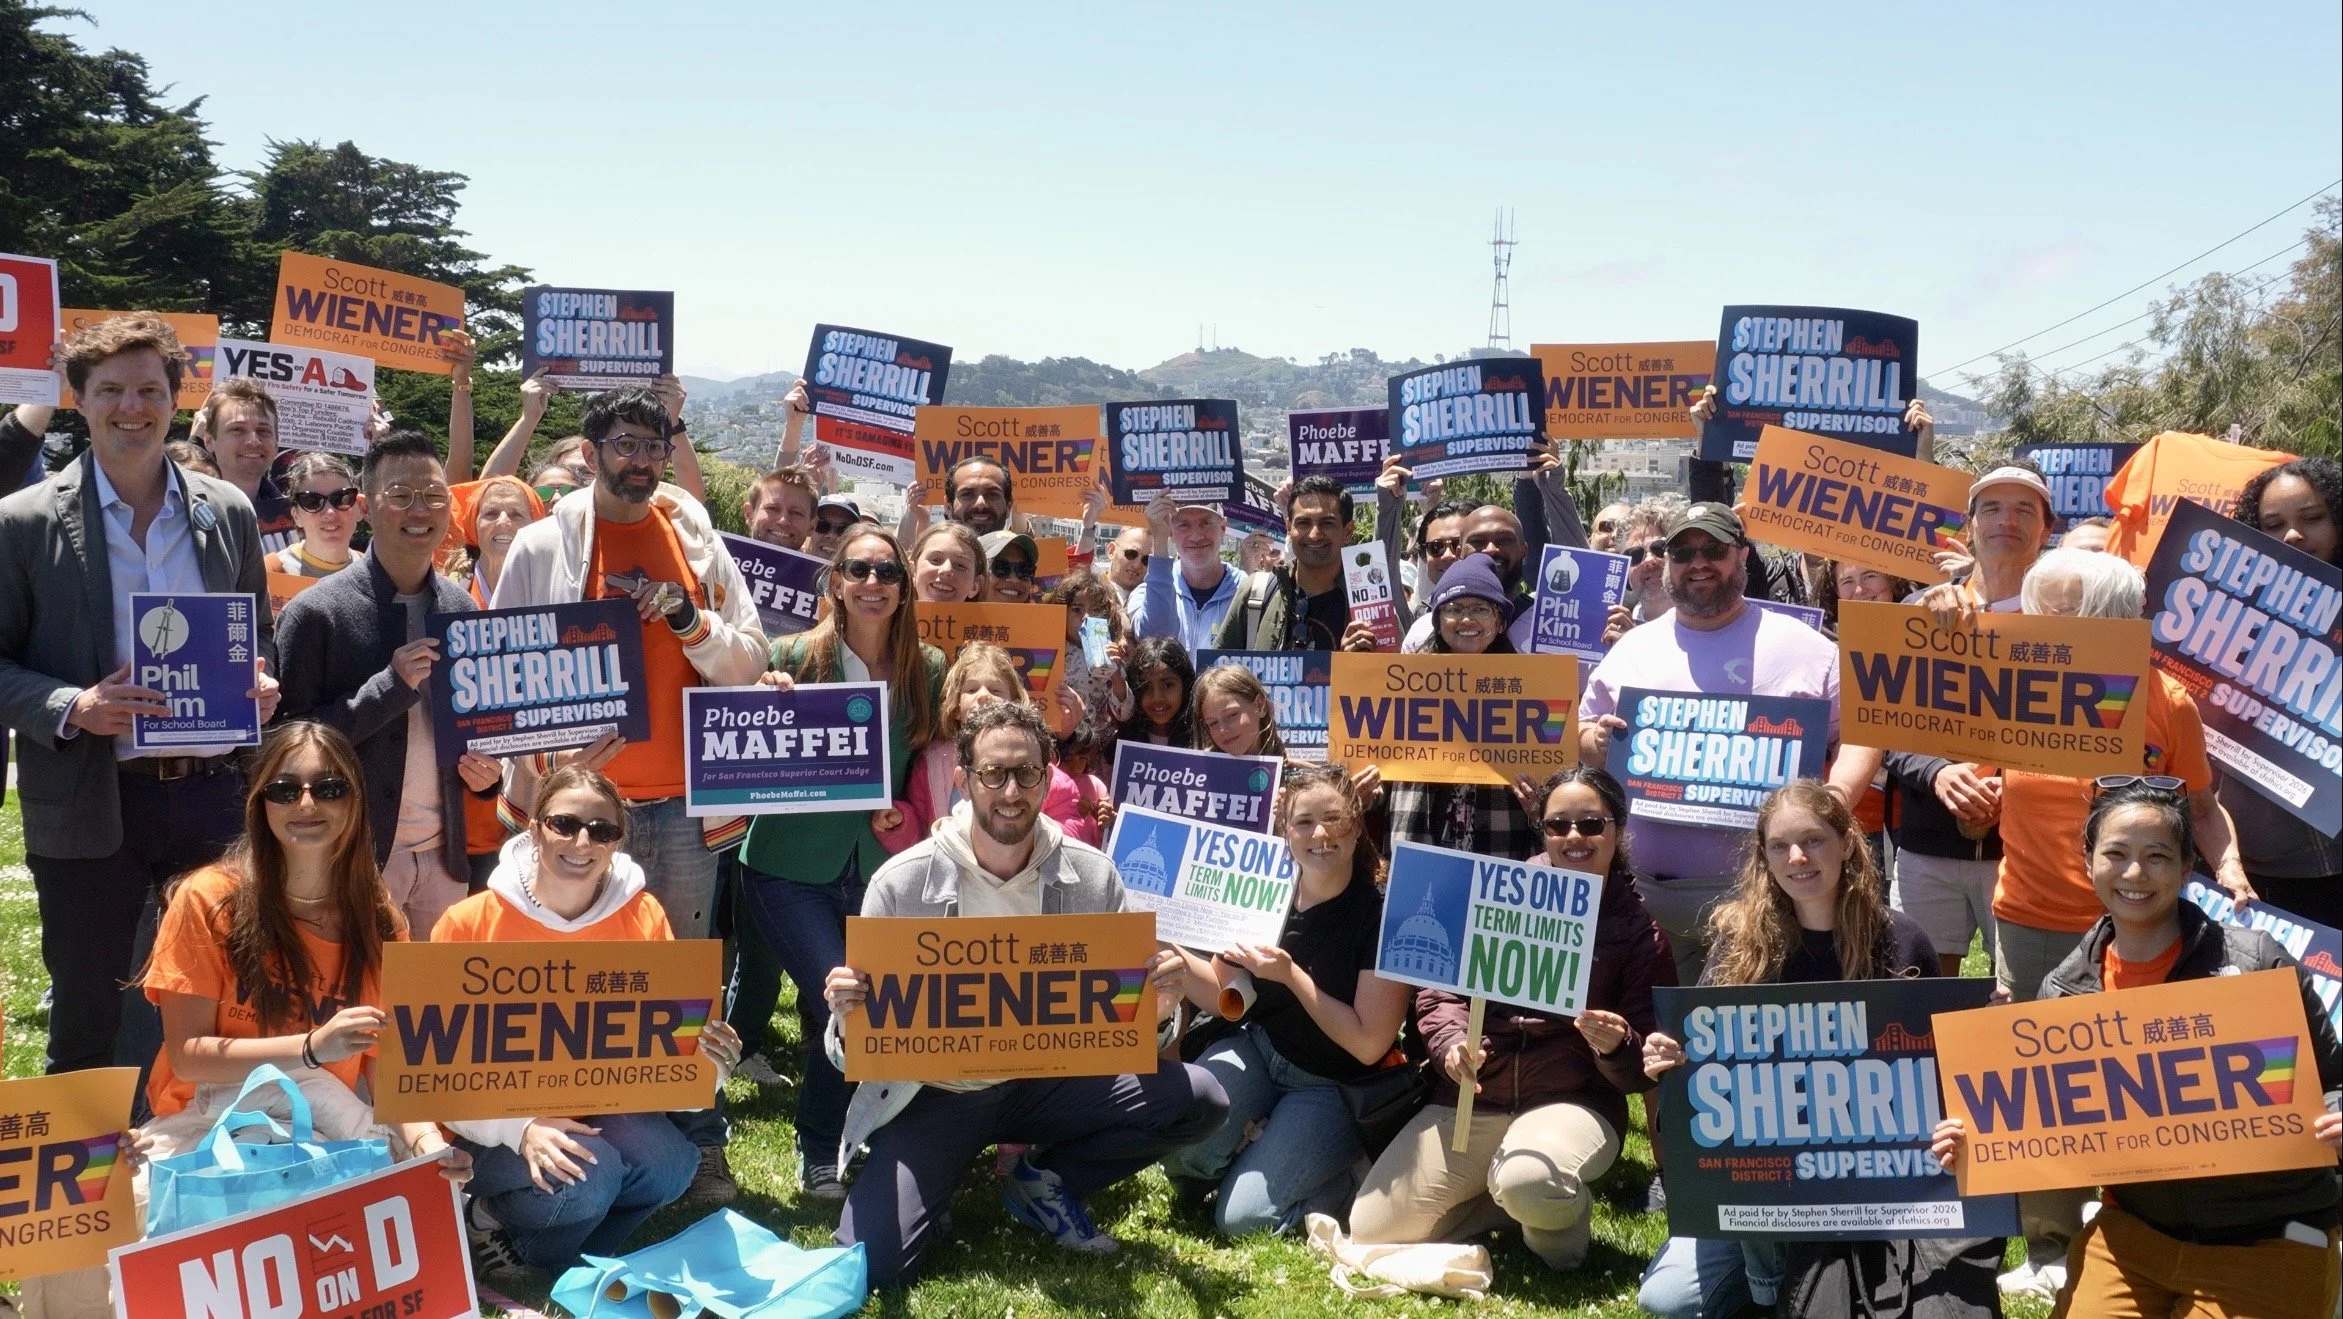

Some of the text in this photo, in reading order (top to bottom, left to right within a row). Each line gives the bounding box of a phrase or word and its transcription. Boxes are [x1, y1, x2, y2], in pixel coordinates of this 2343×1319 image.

[324, 268, 427, 307] Scott 威善高
[285, 285, 445, 346] WIENER
[537, 292, 618, 320] STEPHEN
[285, 323, 379, 350] DEMOCRAT FOR
[536, 318, 663, 360] SHERRILL
[823, 330, 898, 363] STEPHEN
[1732, 316, 1844, 355] STEPHEN
[223, 347, 293, 382] YES
[300, 358, 327, 387] A
[579, 360, 660, 374] SUPERVISOR
[1571, 351, 1674, 373] Scott 威善高
[320, 388, 336, 396] Safer
[337, 390, 367, 400] Tomorrow
[815, 353, 931, 405] SHERRILL
[1401, 366, 1482, 407] STEPHEN
[1544, 374, 1695, 409] WIENER
[1726, 352, 1906, 413] SHERRILL
[957, 415, 1061, 438] Scott 威善高
[1119, 405, 1195, 433] STEPHEN
[1299, 423, 1356, 440] Phoebe
[1402, 392, 1535, 447] SHERRILL
[1614, 416, 1631, 424] FOR
[1742, 411, 1781, 420] FRANCISCO
[1783, 411, 1900, 435] SUPERVISOR
[835, 451, 894, 473] NoOnDSF.com
[1121, 431, 1235, 471] SHERRILL
[2028, 448, 2113, 474] STEPHEN
[1021, 476, 1090, 489] CONGRESS
[1163, 471, 1234, 486] SUPERVISOR
[1804, 445, 1929, 498] Scott 威善高
[2177, 478, 2222, 496] Scott
[1758, 463, 1946, 546] WIENER
[1750, 506, 1857, 545] DEMOCRAT FOR
[1352, 585, 1388, 604] NO D
[1602, 559, 1624, 604] 菲爾金
[2180, 528, 2342, 637] STEPHEN
[1354, 604, 1390, 620] DON'T
[1540, 596, 1580, 620] Phil
[227, 602, 248, 663] 菲爾金
[447, 613, 559, 658] STEPHEN
[963, 626, 1010, 643] 威善高
[1537, 636, 1592, 649] For School Board
[1538, 615, 1580, 639] Kim
[1905, 617, 2073, 665] Scott 威善高
[451, 644, 629, 714] SHERRILL
[1386, 663, 1523, 695] Scott 威善高
[2162, 657, 2214, 690] FRANCISCO
[1850, 651, 2106, 729] WIENER
[143, 719, 226, 729] For School Board
[473, 715, 512, 726] FRANCISCO
[476, 724, 508, 733] DISTRICT
[515, 700, 628, 728] SUPERVISOR
[703, 705, 795, 728] Phoebe
[1339, 695, 1550, 744] WIENER
[1636, 696, 1748, 733] STEPHEN
[479, 727, 598, 748] paid for Stephen Sherrill Supervisor
[702, 726, 869, 761] MAFFEI
[1857, 706, 2124, 755] DEMOCRAT FOR CONGRESS
[1344, 744, 1438, 761] DEMOCRAT
[1442, 752, 1465, 762] FOR
[1469, 748, 1564, 765] CONGRESS
[2216, 736, 2307, 794] Sherrill 2026
[702, 767, 870, 782] for San Francisco Superior Court Judge
[1129, 762, 1207, 788] Phoebe
[1627, 779, 1683, 793] SAN FRANCISCO
[750, 789, 827, 800] PhoebeMaffei.com
[1123, 781, 1262, 822] MAFFEI
[1645, 790, 1675, 800] DISTRICT
[1193, 826, 1278, 877] YES ON
[1184, 882, 1221, 901] LIMITS
[1189, 864, 1223, 887] TERM
[1478, 861, 1591, 917] YES ON B
[1222, 873, 1289, 914] NOW!
[1474, 904, 1584, 948] TERM LIMITS
[916, 931, 1088, 967] Scott 威善高
[461, 956, 650, 995] Scott 威善高
[1466, 933, 1581, 1009] NOW!
[866, 968, 1122, 1029] WIENER
[393, 999, 684, 1066] WIENER
[865, 1029, 1139, 1054] DEMOCRAT FOR CONGRESS
[1683, 1000, 1869, 1063] STEPHEN
[2011, 1011, 2216, 1059] Scott 威善高
[398, 1063, 698, 1094] DEMOCRAT FOR CONGRESS
[1954, 1042, 2274, 1135] WIENER
[1974, 1112, 2305, 1165] DEMOCRAT FOR CONGRESS
[1698, 1156, 1792, 1169] SAN FRANCISCO
[1731, 1169, 1792, 1182] DISTRICT 2
[1724, 1205, 1957, 1219] Ad paid for by Stephen Sherrill for Supervisor 2026
[1729, 1216, 1949, 1227] Financial disclosures are available at sfethics.org
[179, 1195, 420, 1319] NO ON D
[402, 1289, 424, 1315] SF
